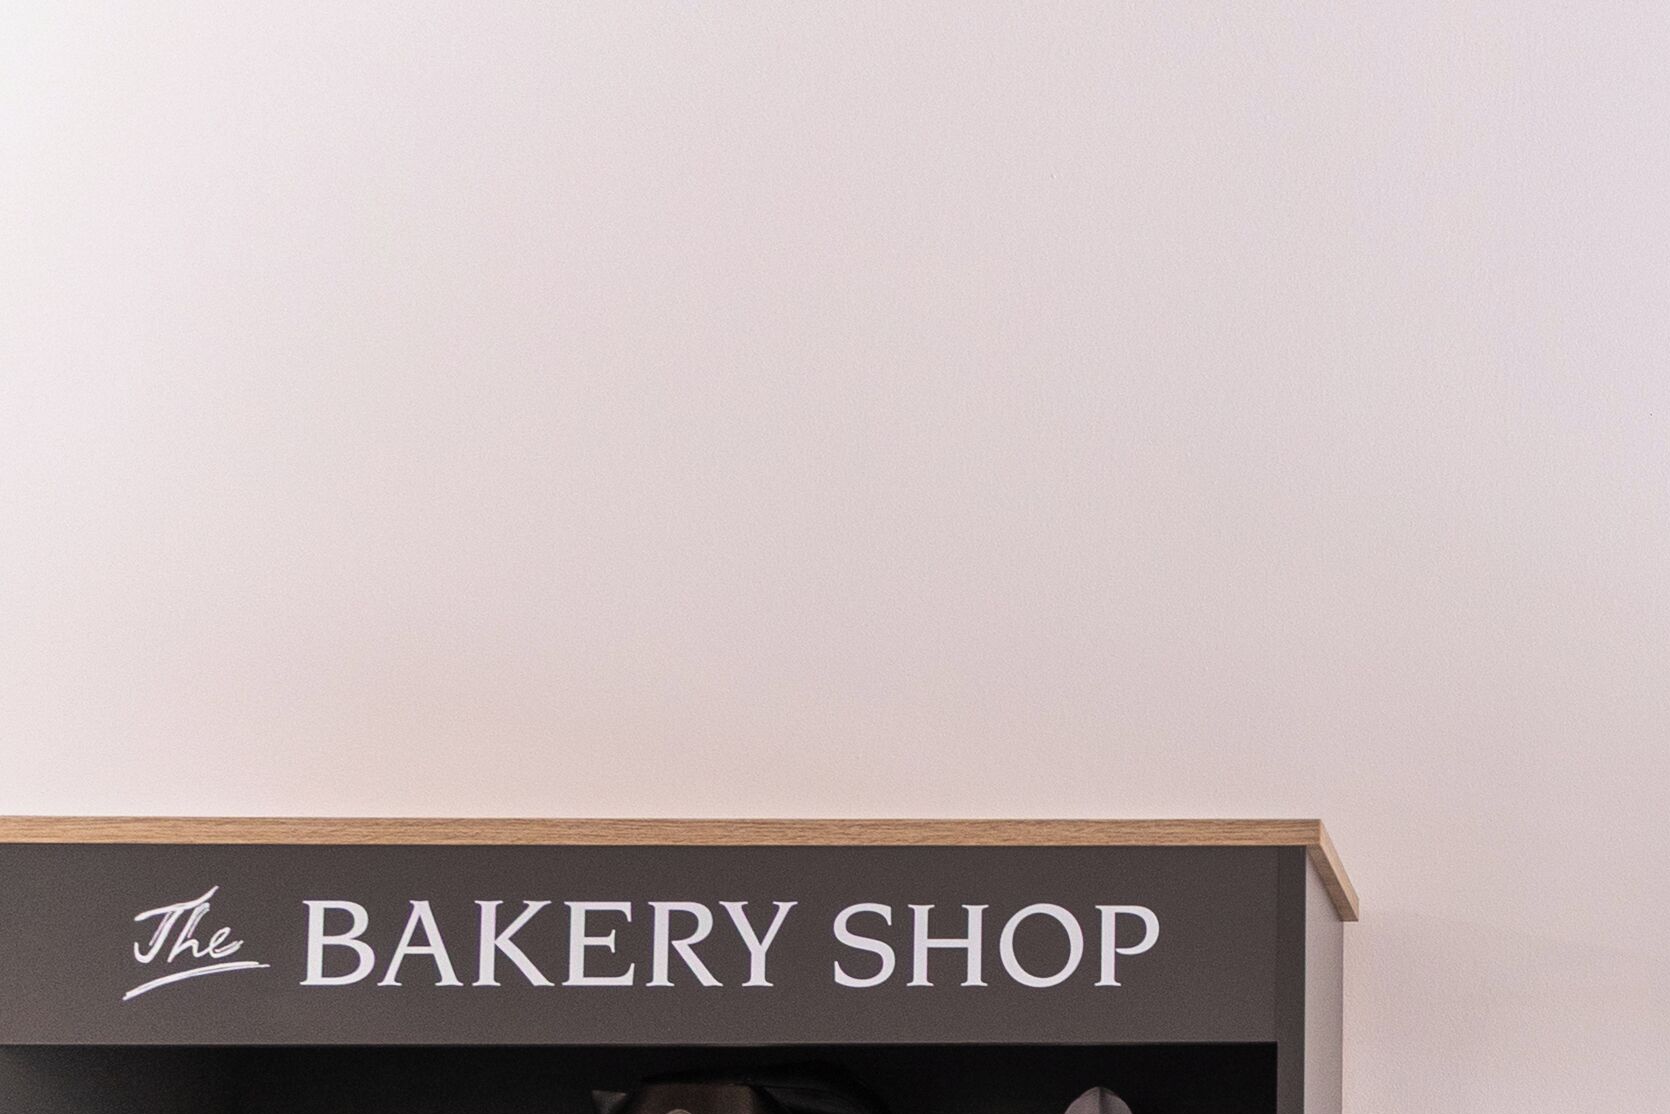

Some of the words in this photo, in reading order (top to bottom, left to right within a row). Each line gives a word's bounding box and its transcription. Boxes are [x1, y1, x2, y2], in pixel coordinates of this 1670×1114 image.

[133, 885, 246, 966] The
[299, 899, 799, 988] BAKERY
[832, 902, 1161, 989] SHOP
